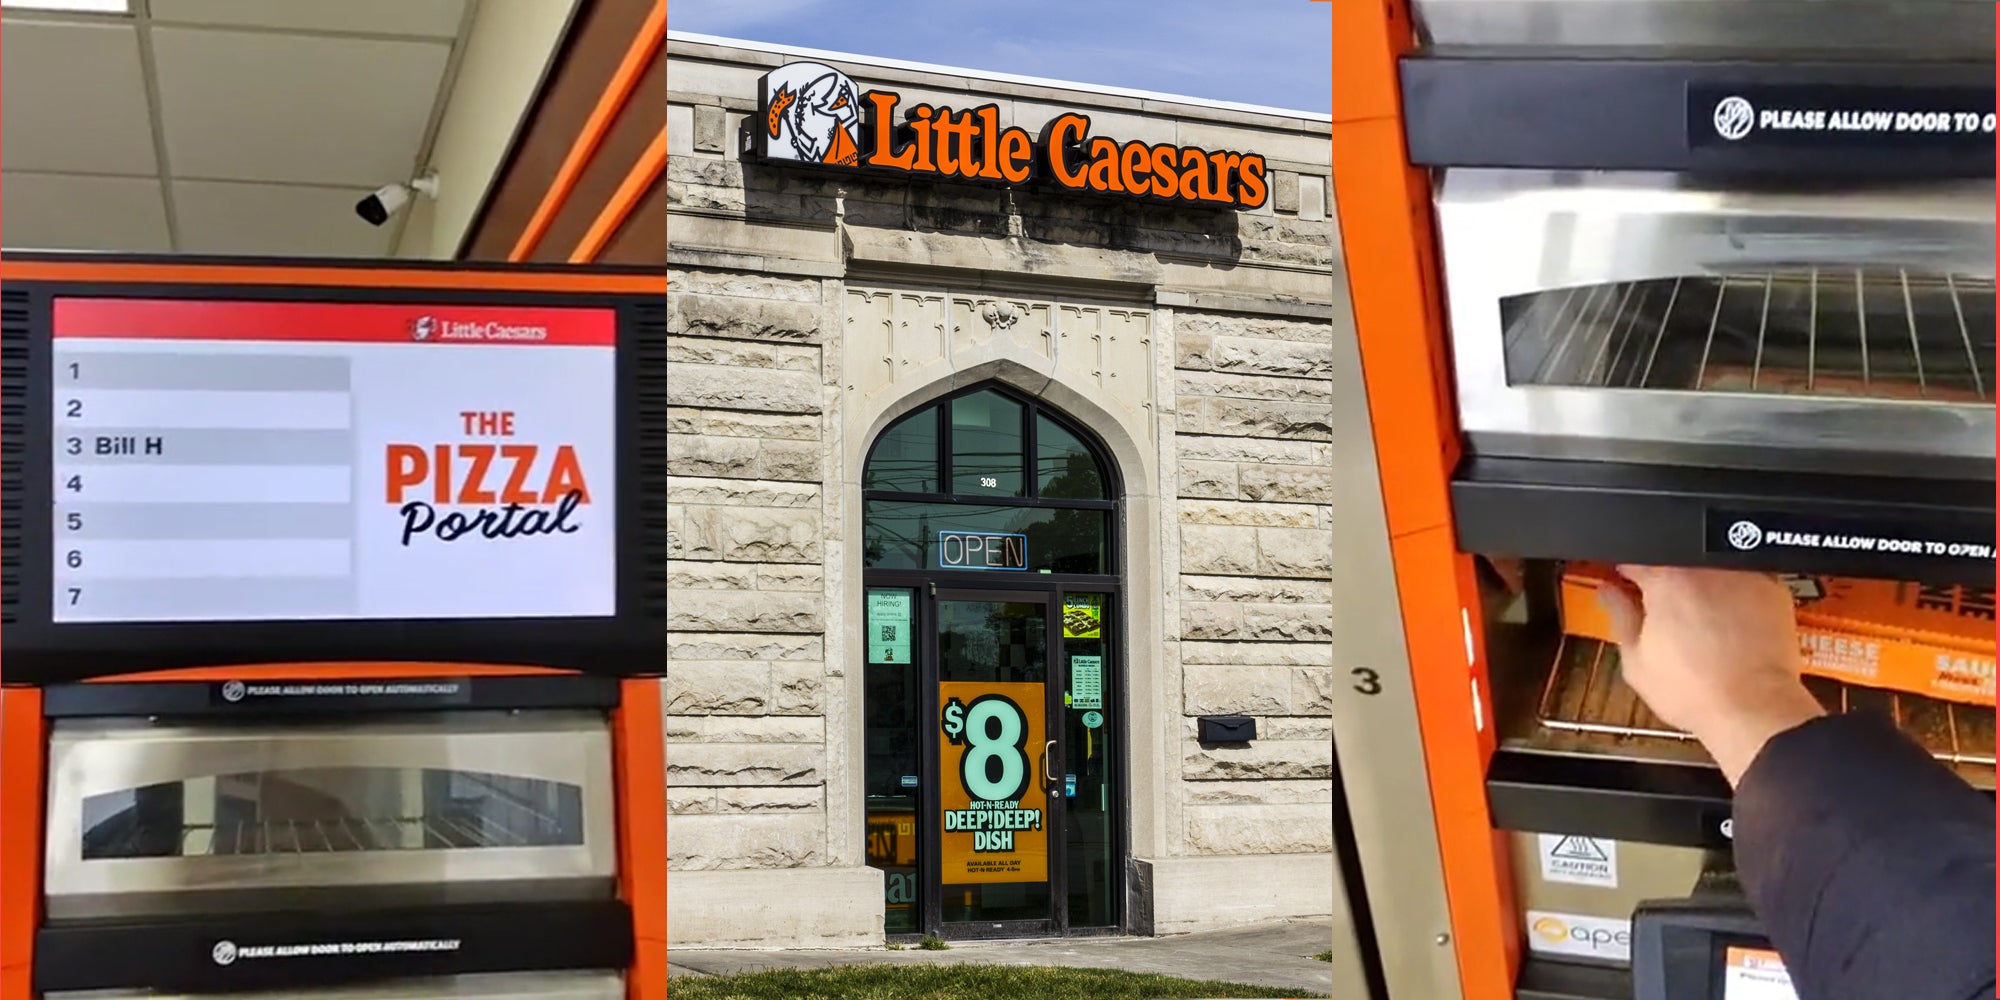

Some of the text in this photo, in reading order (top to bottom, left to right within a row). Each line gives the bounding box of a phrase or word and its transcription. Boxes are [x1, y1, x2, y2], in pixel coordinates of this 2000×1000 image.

[1760, 110, 1826, 129] PLEASE
[1828, 111, 1893, 130] ALLOW
[1895, 112, 1951, 131] DOOR
[1955, 113, 1979, 132] TO
[868, 91, 1267, 207] Little Caesars
[441, 320, 548, 340] Little Caesars
[70, 362, 79, 380] 1
[66, 399, 82, 418] 2
[460, 411, 515, 436] THE
[66, 436, 163, 455] 3 Bill H
[66, 474, 82, 492] 4
[386, 443, 591, 504] PIZZA
[980, 477, 997, 488] 308
[66, 512, 82, 530] 5
[399, 488, 581, 547] Portal
[944, 535, 1023, 567] OPEN
[1766, 531, 1820, 547] PLEASE
[1822, 534, 1876, 550] ALLOW
[1878, 537, 1922, 554] DOOR
[1925, 540, 1946, 555] TO
[1948, 542, 1989, 558] OPEN
[66, 550, 82, 568] 6
[67, 588, 82, 605] 7
[881, 592, 897, 600] NOW
[1800, 632, 1880, 658] HEESE
[247, 686, 281, 695] PLEASE
[283, 685, 315, 695] ALLOW
[316, 685, 344, 694] DOOR
[345, 685, 358, 694] TO
[359, 685, 383, 694] OPEN
[1351, 666, 1382, 696] 3
[945, 699, 1024, 800] $8
[970, 800, 1020, 810] HOT-N-READY
[974, 830, 1014, 851] DISH
[1551, 860, 1608, 873] CAUTION
[239, 947, 274, 957] PLEASE
[276, 945, 310, 956] ALLOW
[311, 944, 339, 955] DOOR
[341, 943, 354, 954] TO
